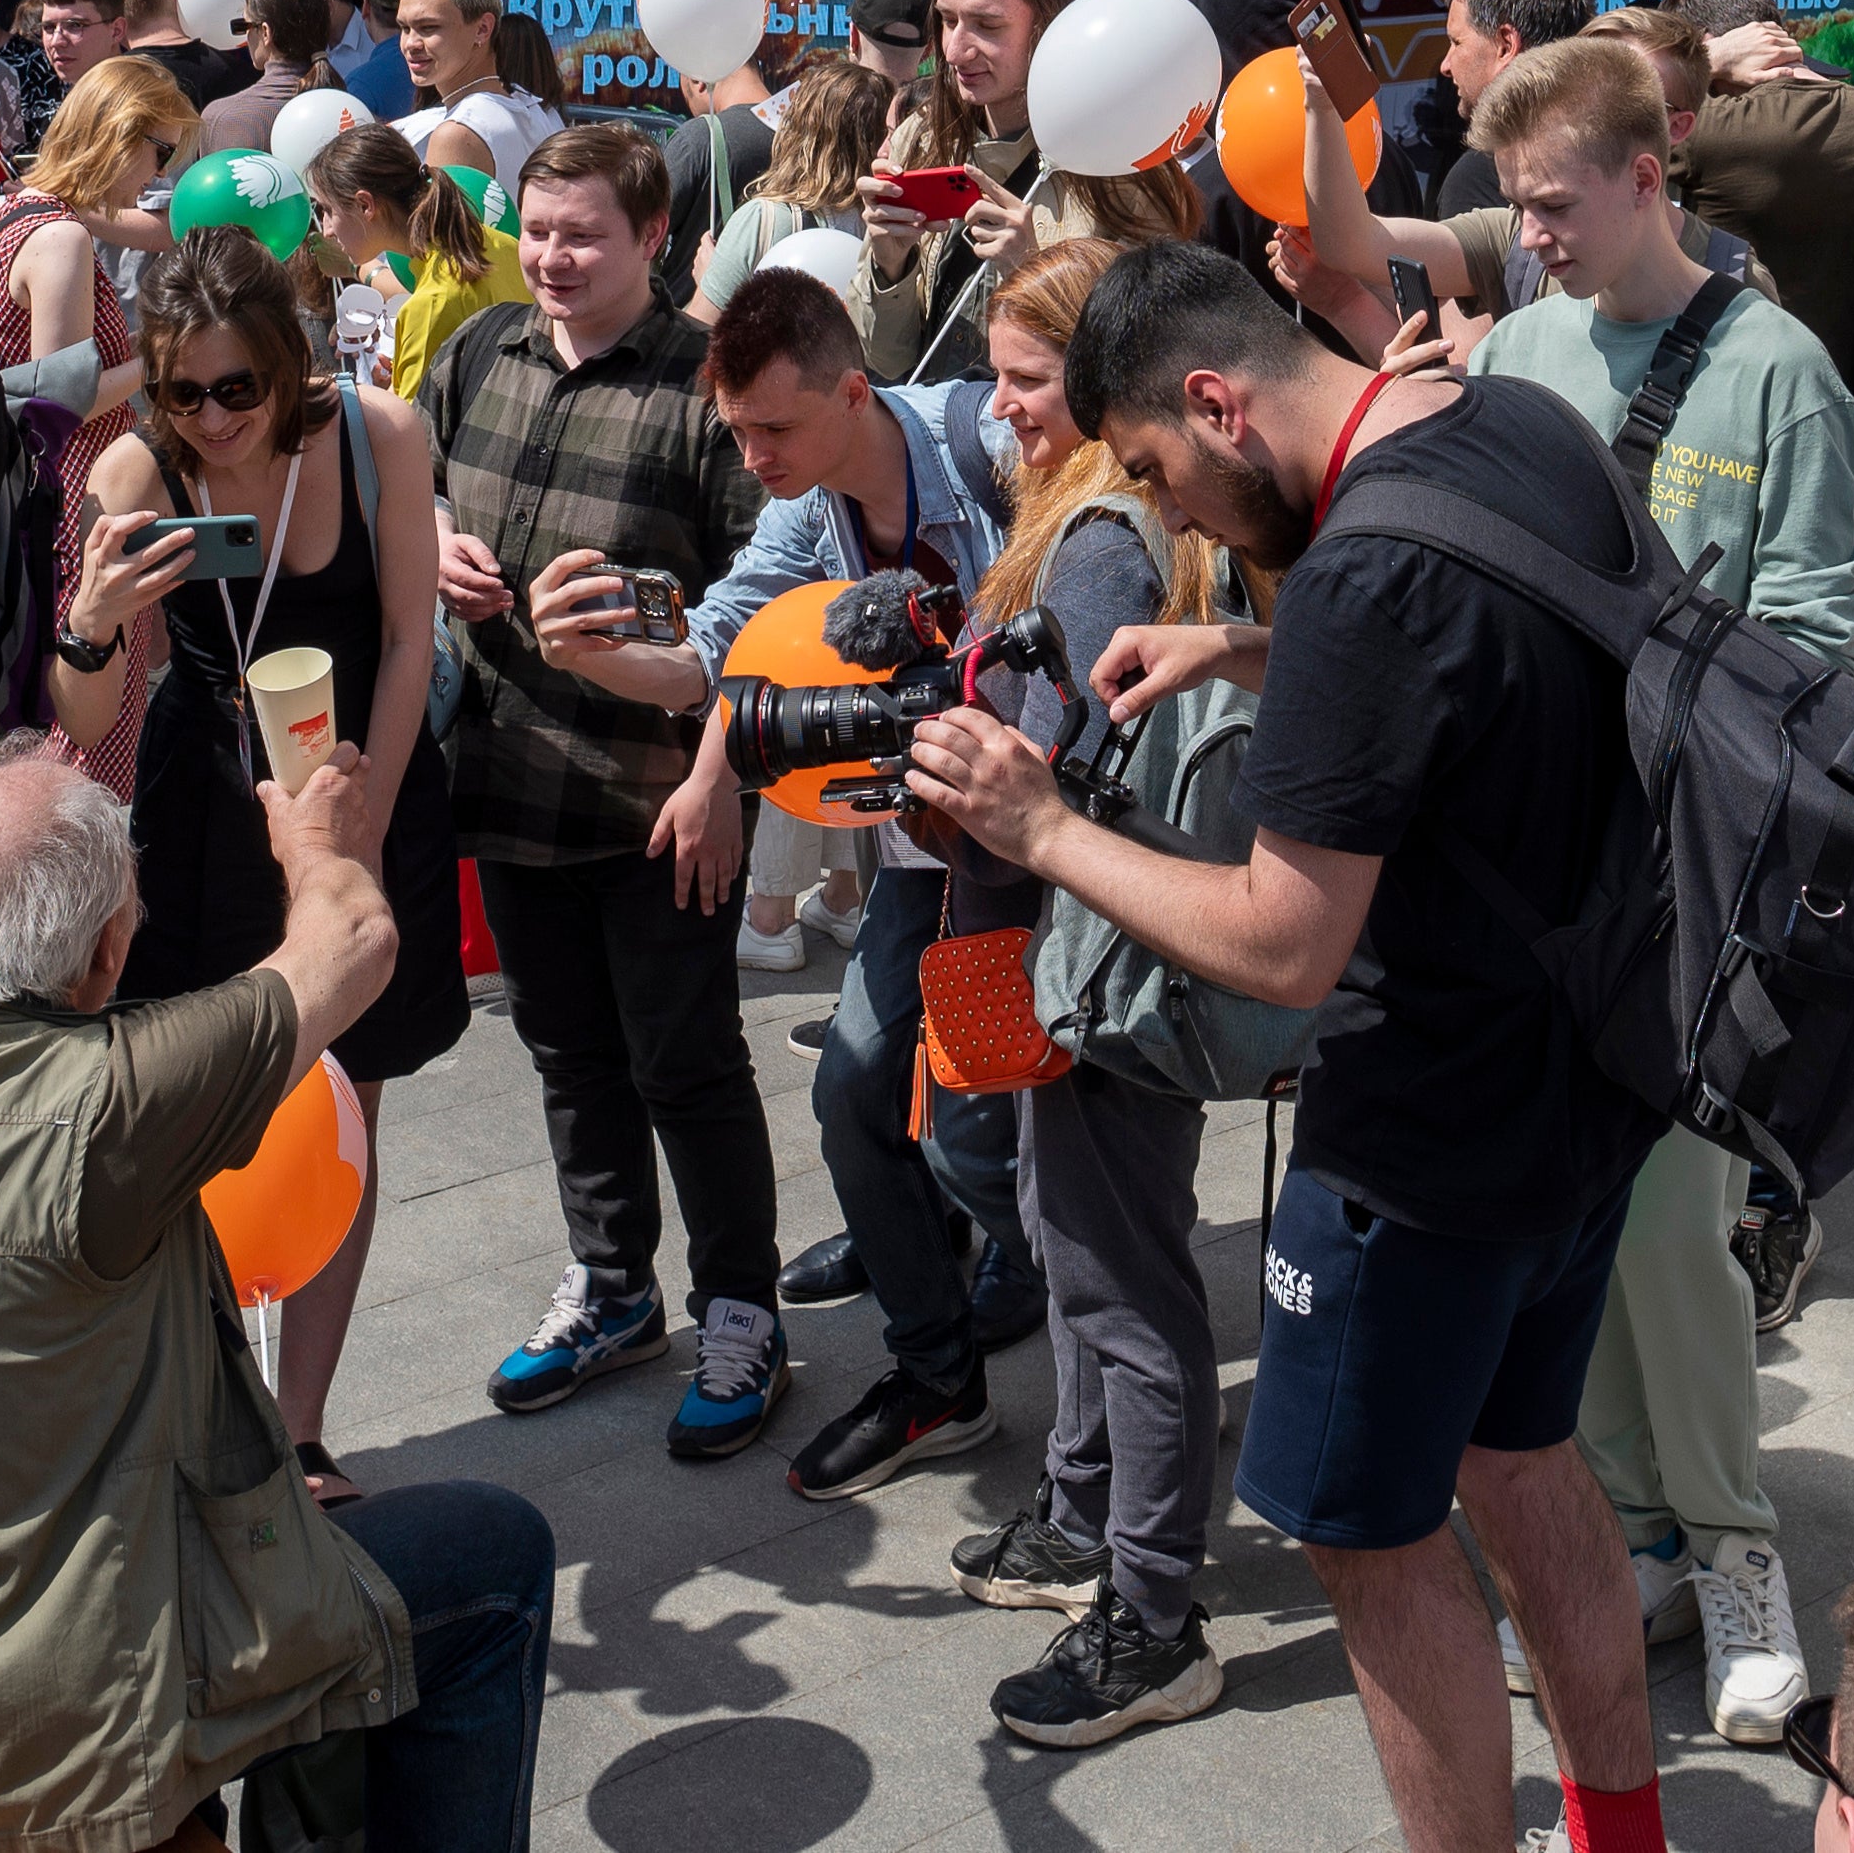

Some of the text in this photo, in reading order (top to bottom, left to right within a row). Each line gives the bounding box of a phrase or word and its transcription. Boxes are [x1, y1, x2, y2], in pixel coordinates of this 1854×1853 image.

[581, 53, 681, 95] рол
[1665, 465, 1704, 488] NEW
[1671, 443, 1708, 470] YOU
[1709, 455, 1759, 484] HAVE
[1648, 482, 1698, 508] SSAGE
[1663, 507, 1679, 524] IT
